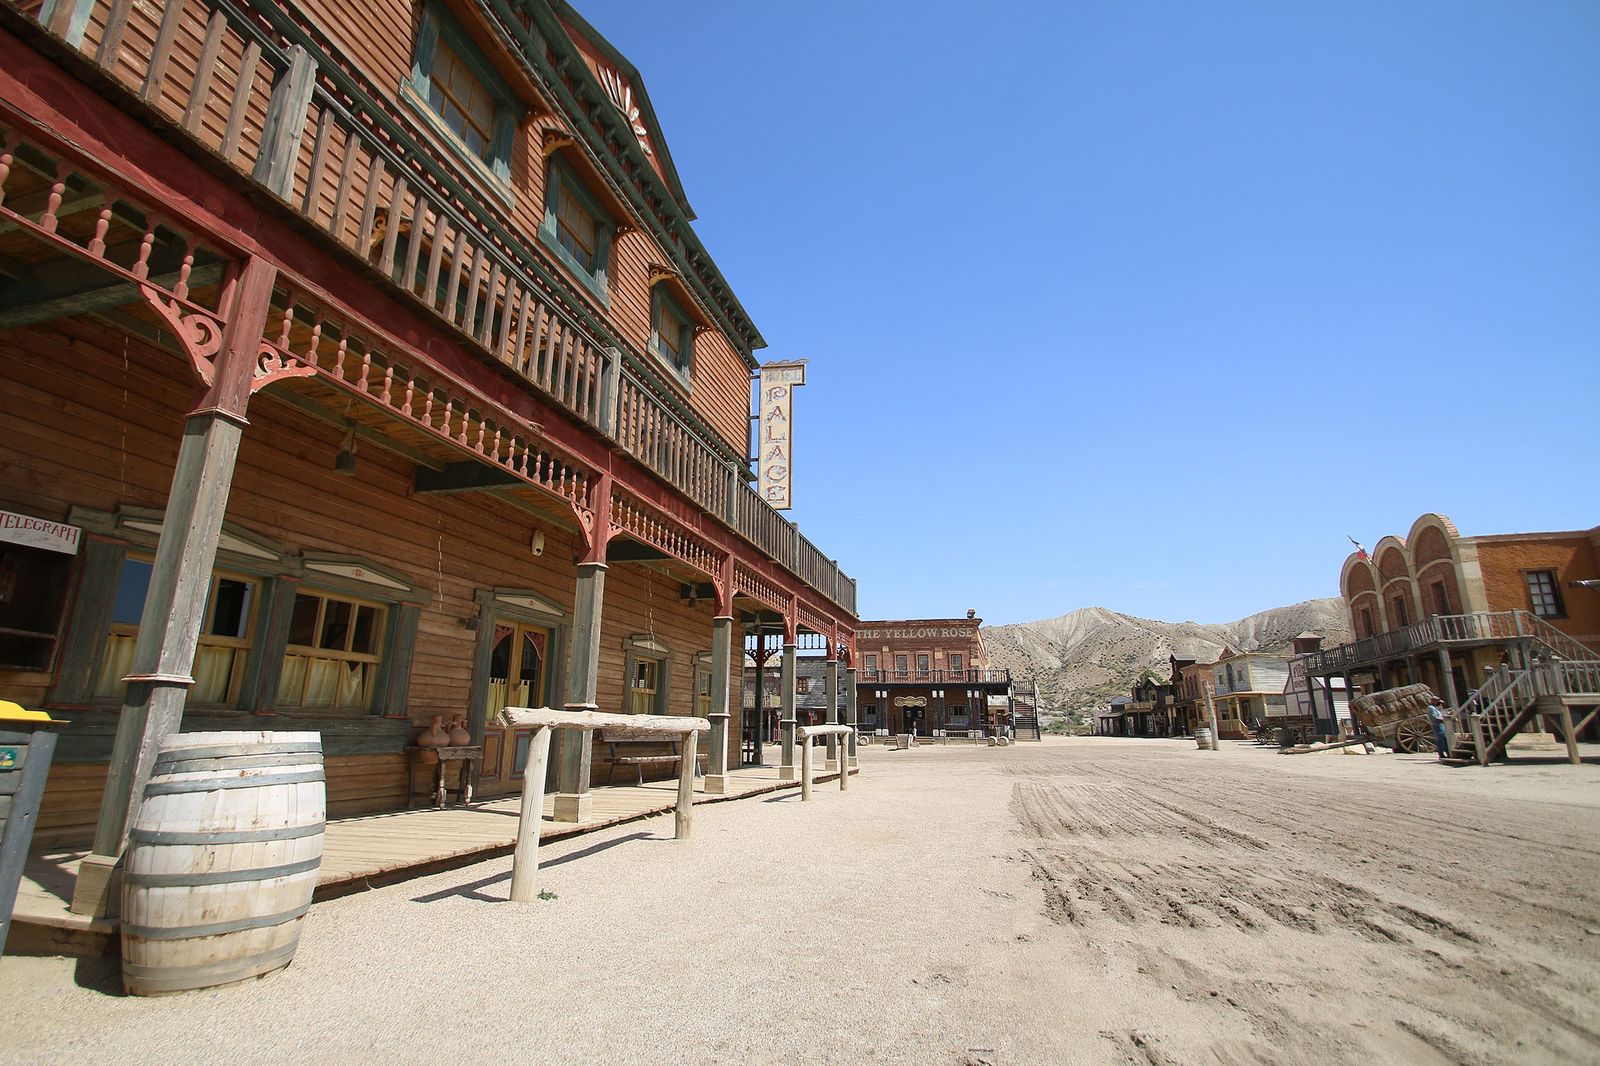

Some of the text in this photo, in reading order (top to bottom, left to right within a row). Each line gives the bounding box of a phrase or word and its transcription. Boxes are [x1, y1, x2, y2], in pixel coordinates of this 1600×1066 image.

[765, 386, 787, 504] PALACE
[0, 512, 78, 545] TELEGRAPH
[855, 627, 974, 639] THE YELLOW ROSE
